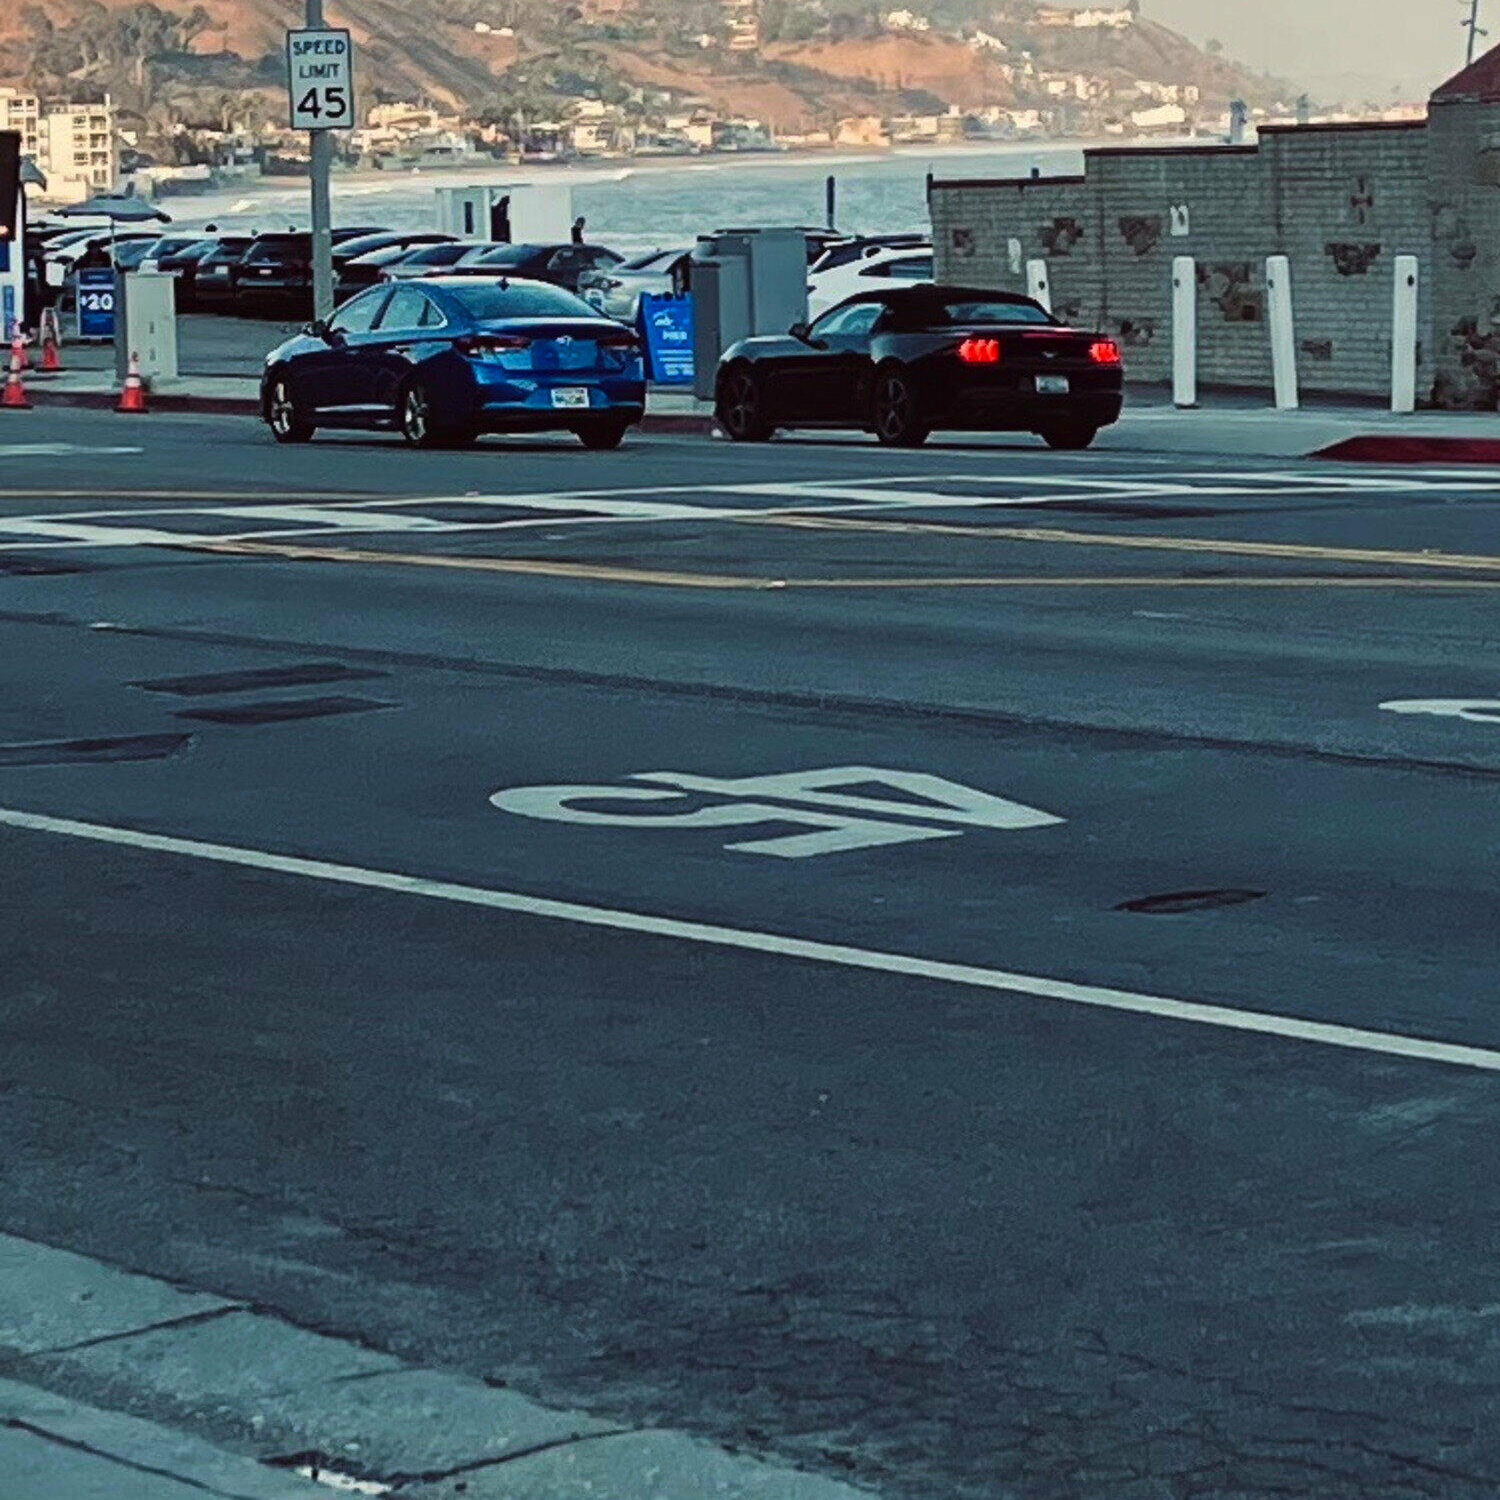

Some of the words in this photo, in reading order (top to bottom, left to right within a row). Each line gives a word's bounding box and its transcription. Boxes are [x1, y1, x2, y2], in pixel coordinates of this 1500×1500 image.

[293, 39, 346, 56] SPEED
[299, 63, 340, 79] LIMIT
[297, 87, 347, 118] 45
